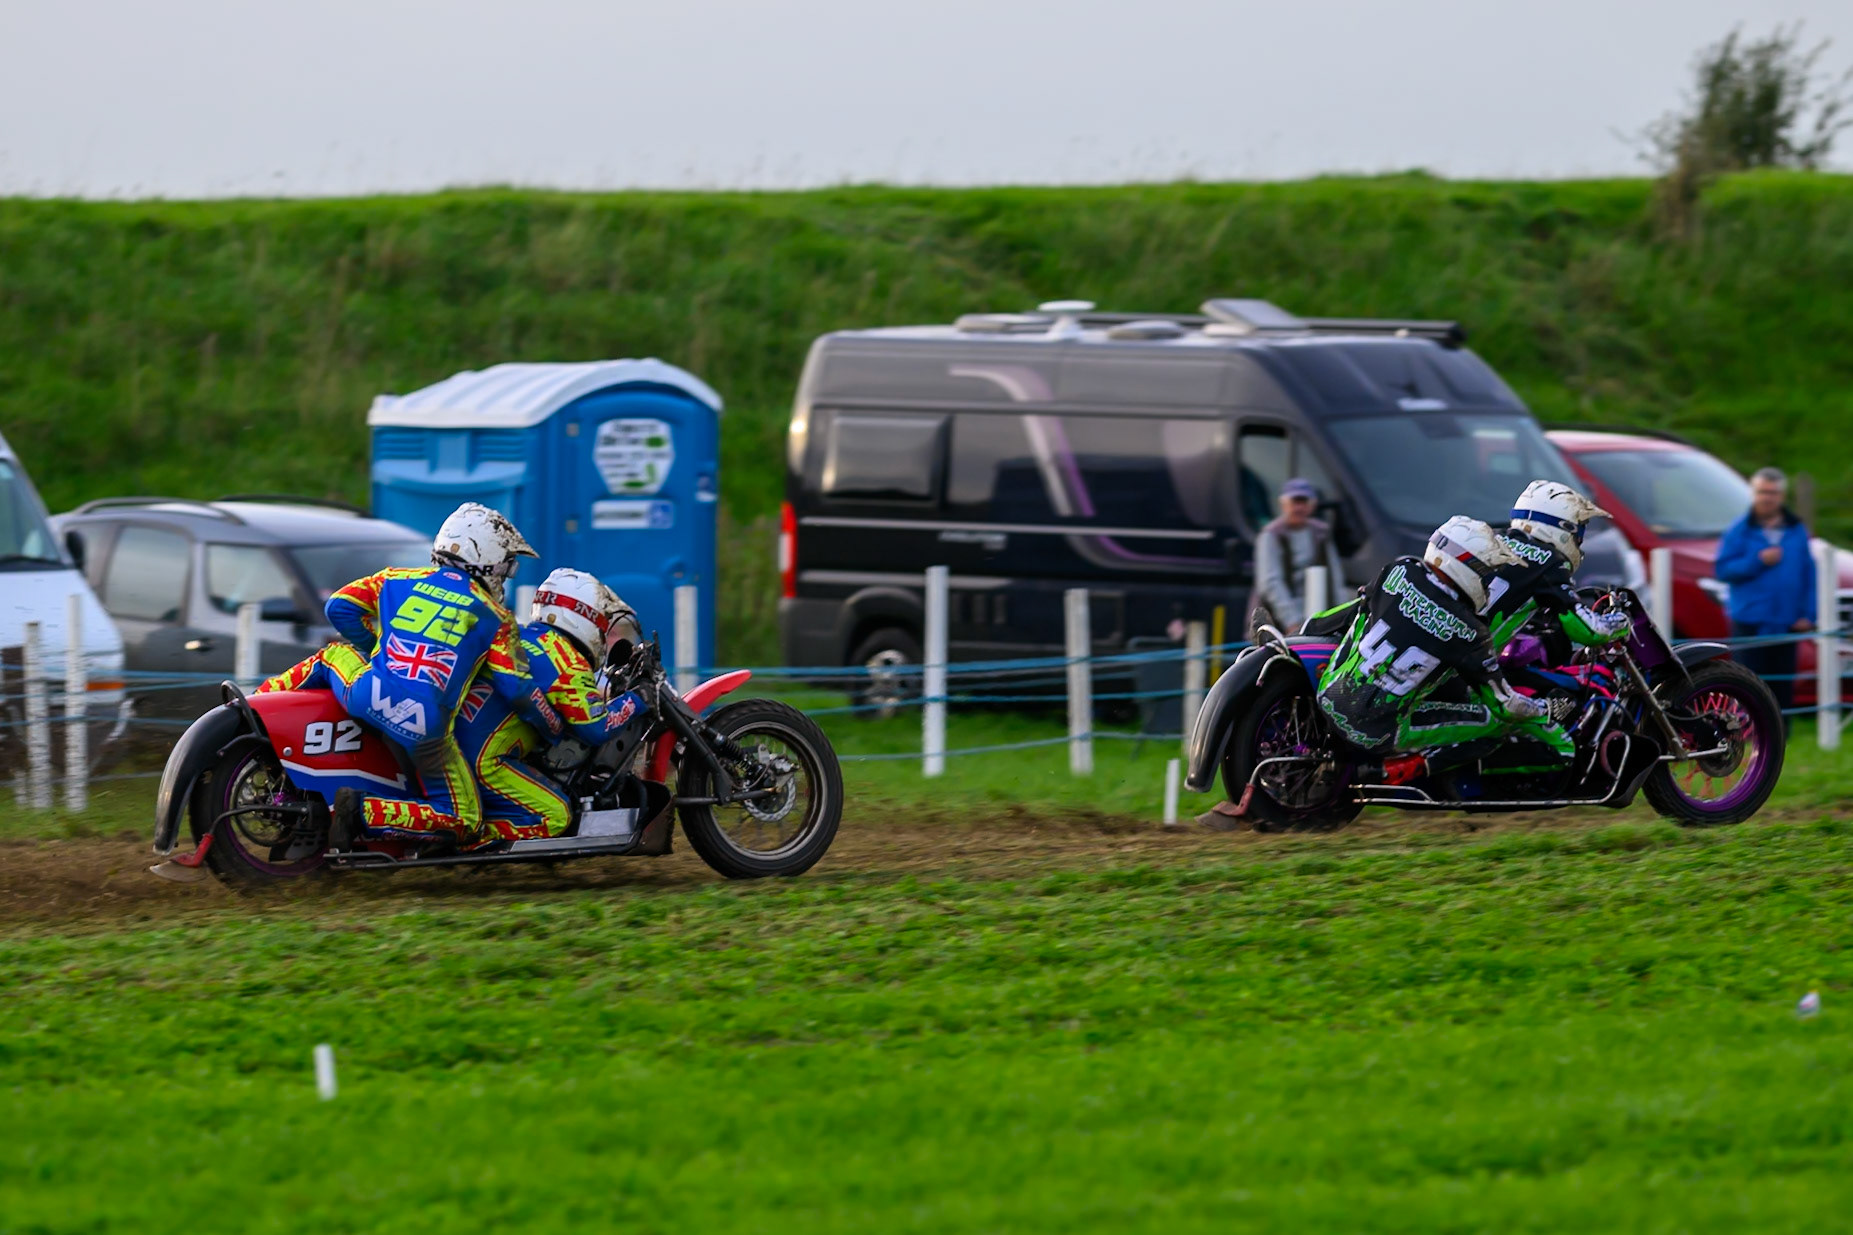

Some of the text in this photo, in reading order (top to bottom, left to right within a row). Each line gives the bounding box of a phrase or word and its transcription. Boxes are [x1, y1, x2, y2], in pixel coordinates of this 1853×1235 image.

[412, 582, 475, 607] WEBB
[1382, 565, 1477, 641] WINTERBURN
[1399, 596, 1453, 641] RACING
[390, 595, 479, 647] 92
[1358, 618, 1441, 696] 49
[371, 675, 426, 735] WA
[303, 719, 363, 755] 92
